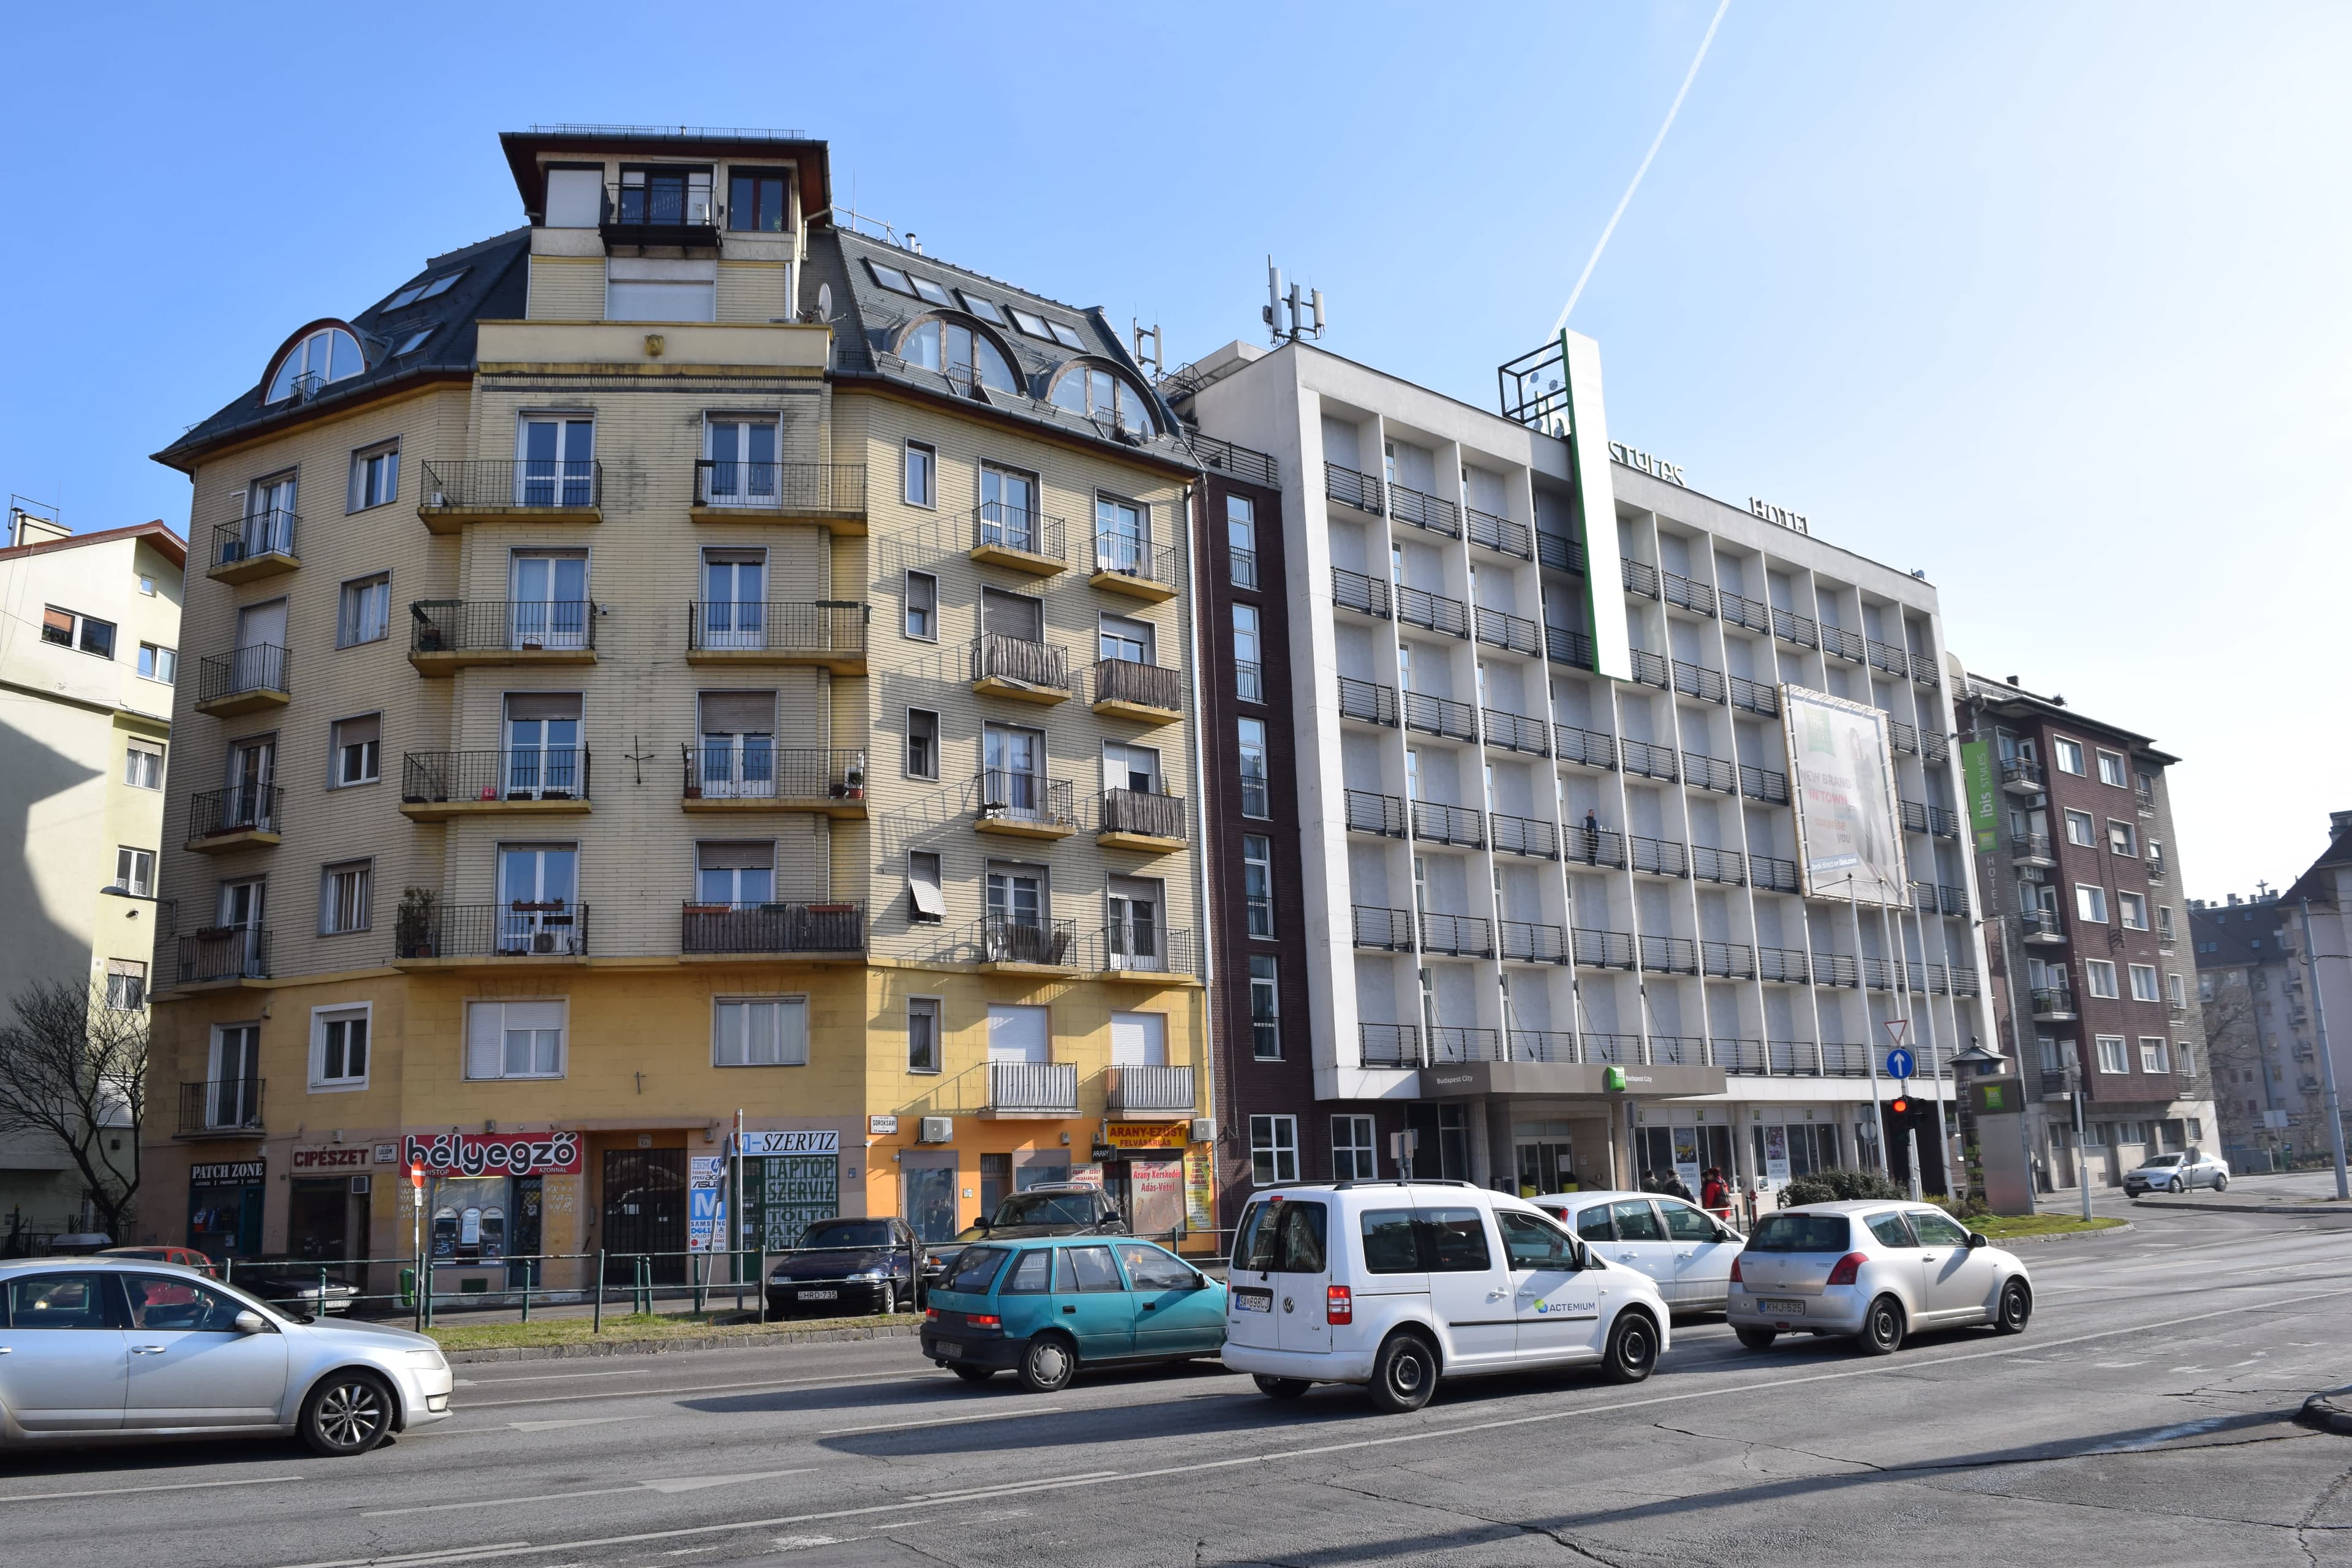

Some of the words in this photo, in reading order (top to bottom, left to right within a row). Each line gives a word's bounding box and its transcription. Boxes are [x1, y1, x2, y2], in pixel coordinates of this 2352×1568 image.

[1800, 769, 1820, 782] NEW
[1822, 774, 1852, 789] BRAND
[1820, 791, 1849, 804] TOWN
[1979, 792, 1993, 818] ibis
[1986, 856, 2000, 910] HOTEL
[1436, 1076, 1461, 1085] Budapest
[293, 1145, 369, 1167] CIPÉSZET
[405, 1131, 578, 1177] bélyegző
[192, 1164, 229, 1178] PATCH
[232, 1163, 263, 1177] ZONE
[767, 1157, 834, 1178] LAPTOP
[1133, 1170, 1150, 1181] Arany
[768, 1181, 834, 1202] SZERVIZ
[1141, 1182, 1175, 1192] Adás-Vétel
[804, 1291, 837, 1299] HRD-735
[1550, 1302, 1596, 1312] ACTEMIUM
[1766, 1302, 1802, 1313] KHJ-525
